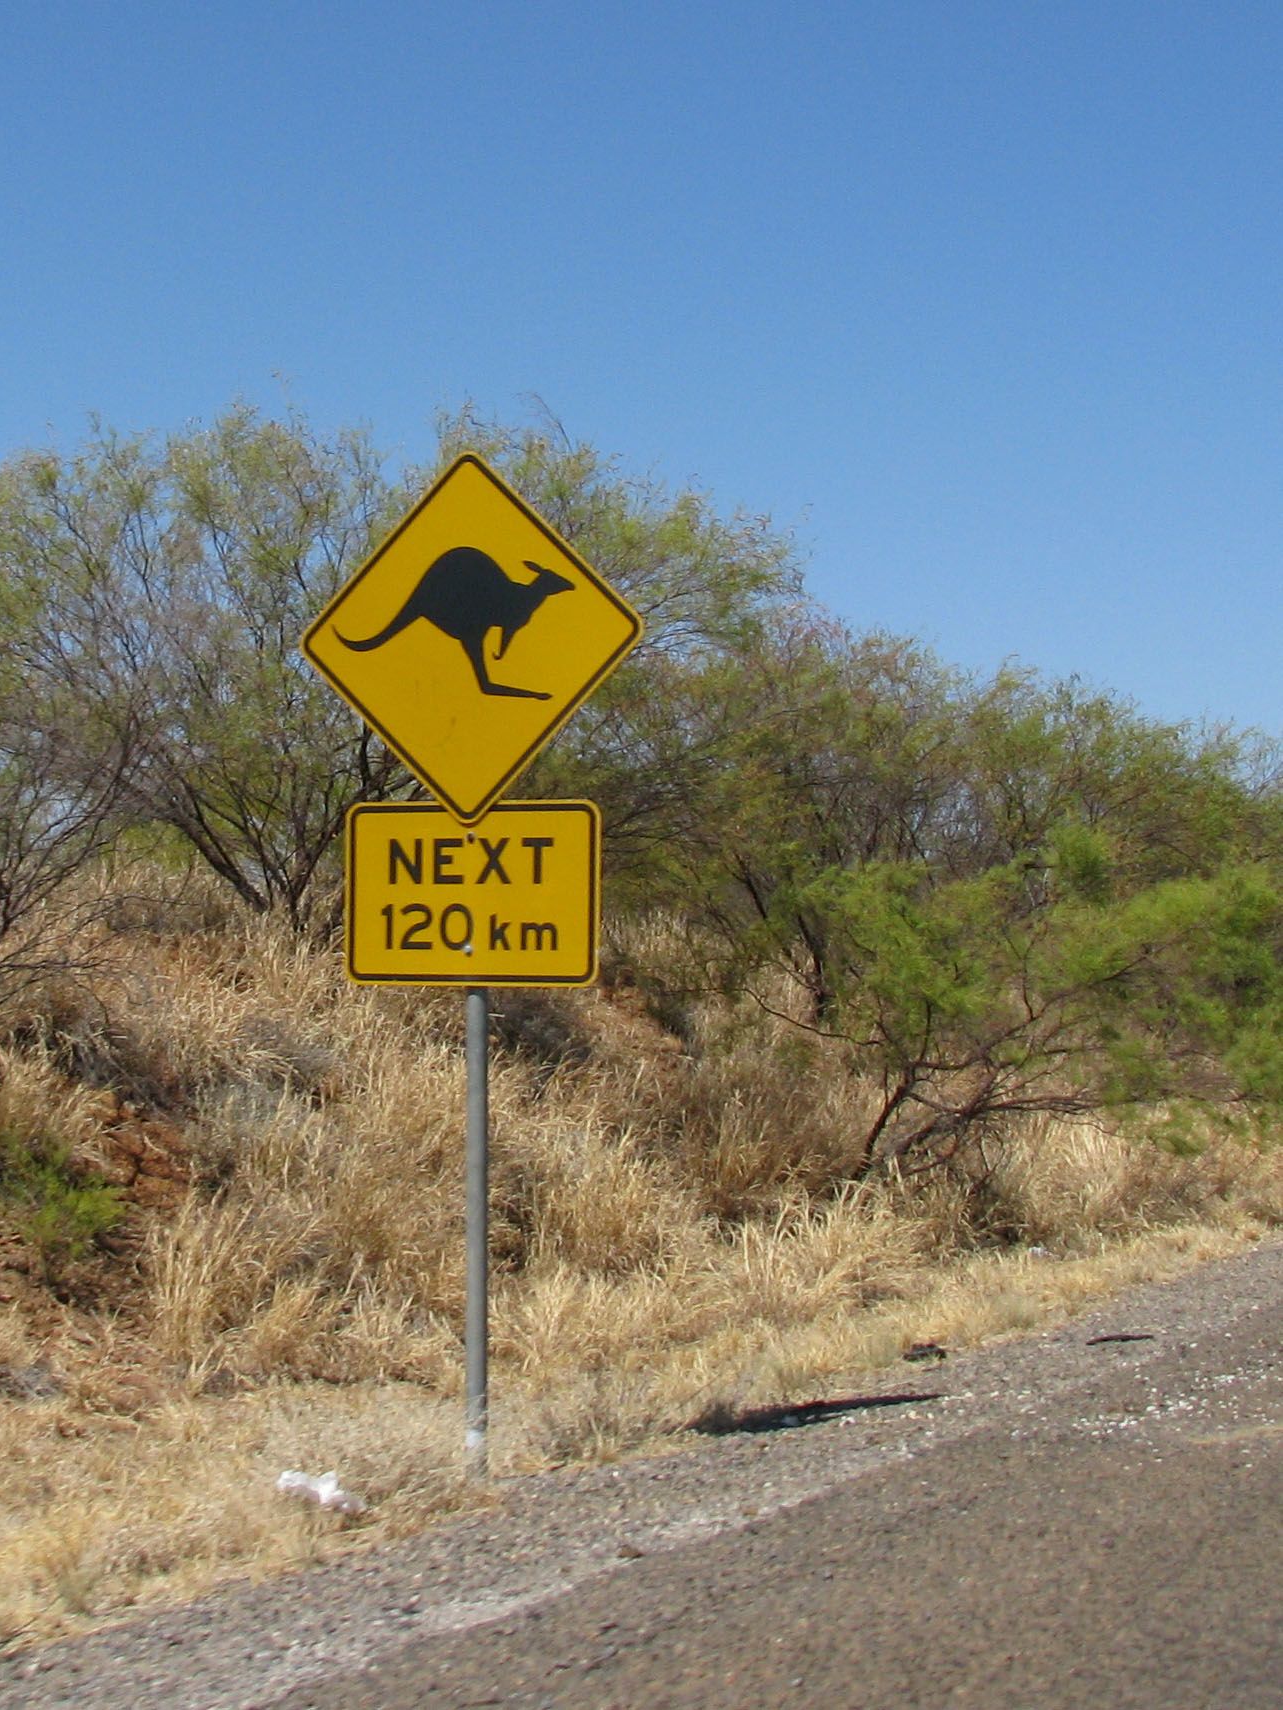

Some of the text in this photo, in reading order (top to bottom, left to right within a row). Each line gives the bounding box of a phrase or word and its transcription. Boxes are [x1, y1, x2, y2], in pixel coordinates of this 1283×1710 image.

[389, 837, 554, 885] NEXT
[381, 903, 558, 951] 120 km
